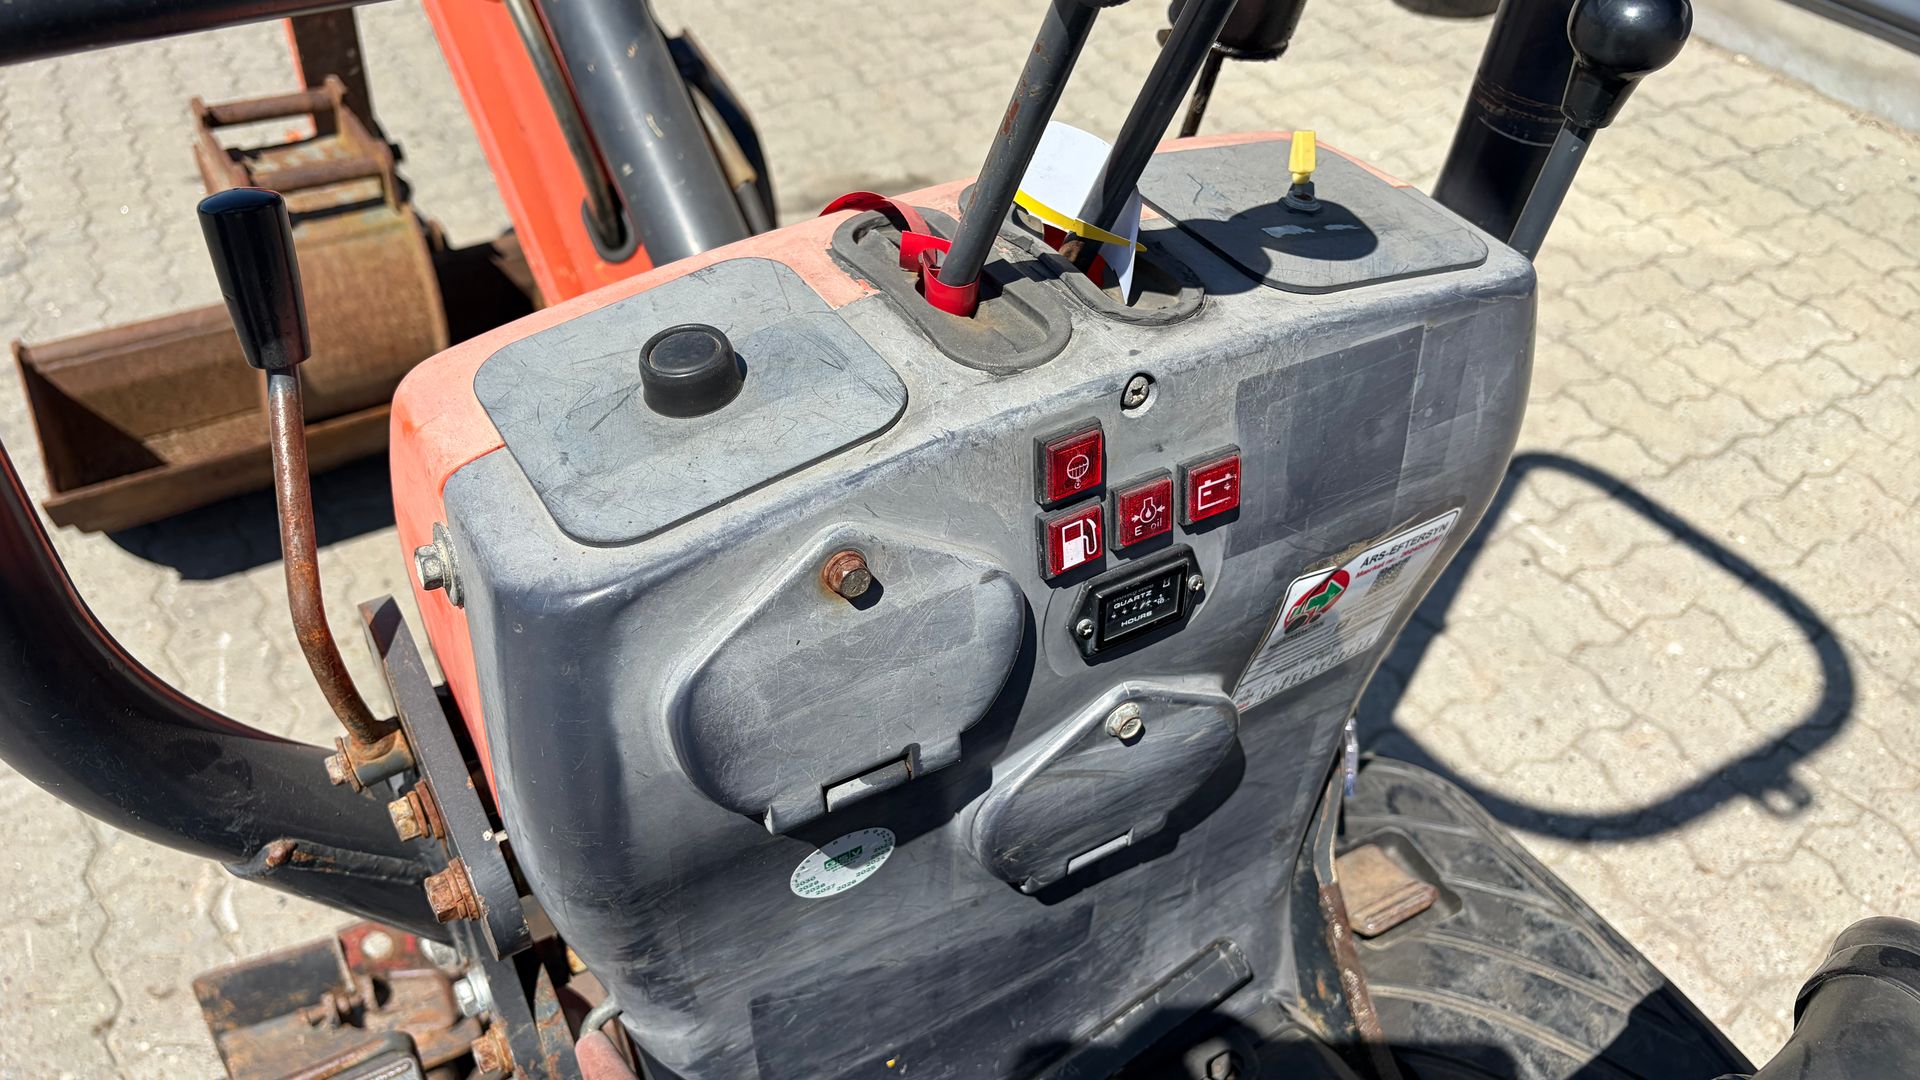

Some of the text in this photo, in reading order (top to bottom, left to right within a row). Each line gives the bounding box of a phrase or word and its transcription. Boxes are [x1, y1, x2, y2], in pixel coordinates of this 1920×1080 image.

[1134, 525, 1143, 536] E
[1113, 590, 1153, 609] QUARTZ
[1121, 610, 1153, 627] HOURS
